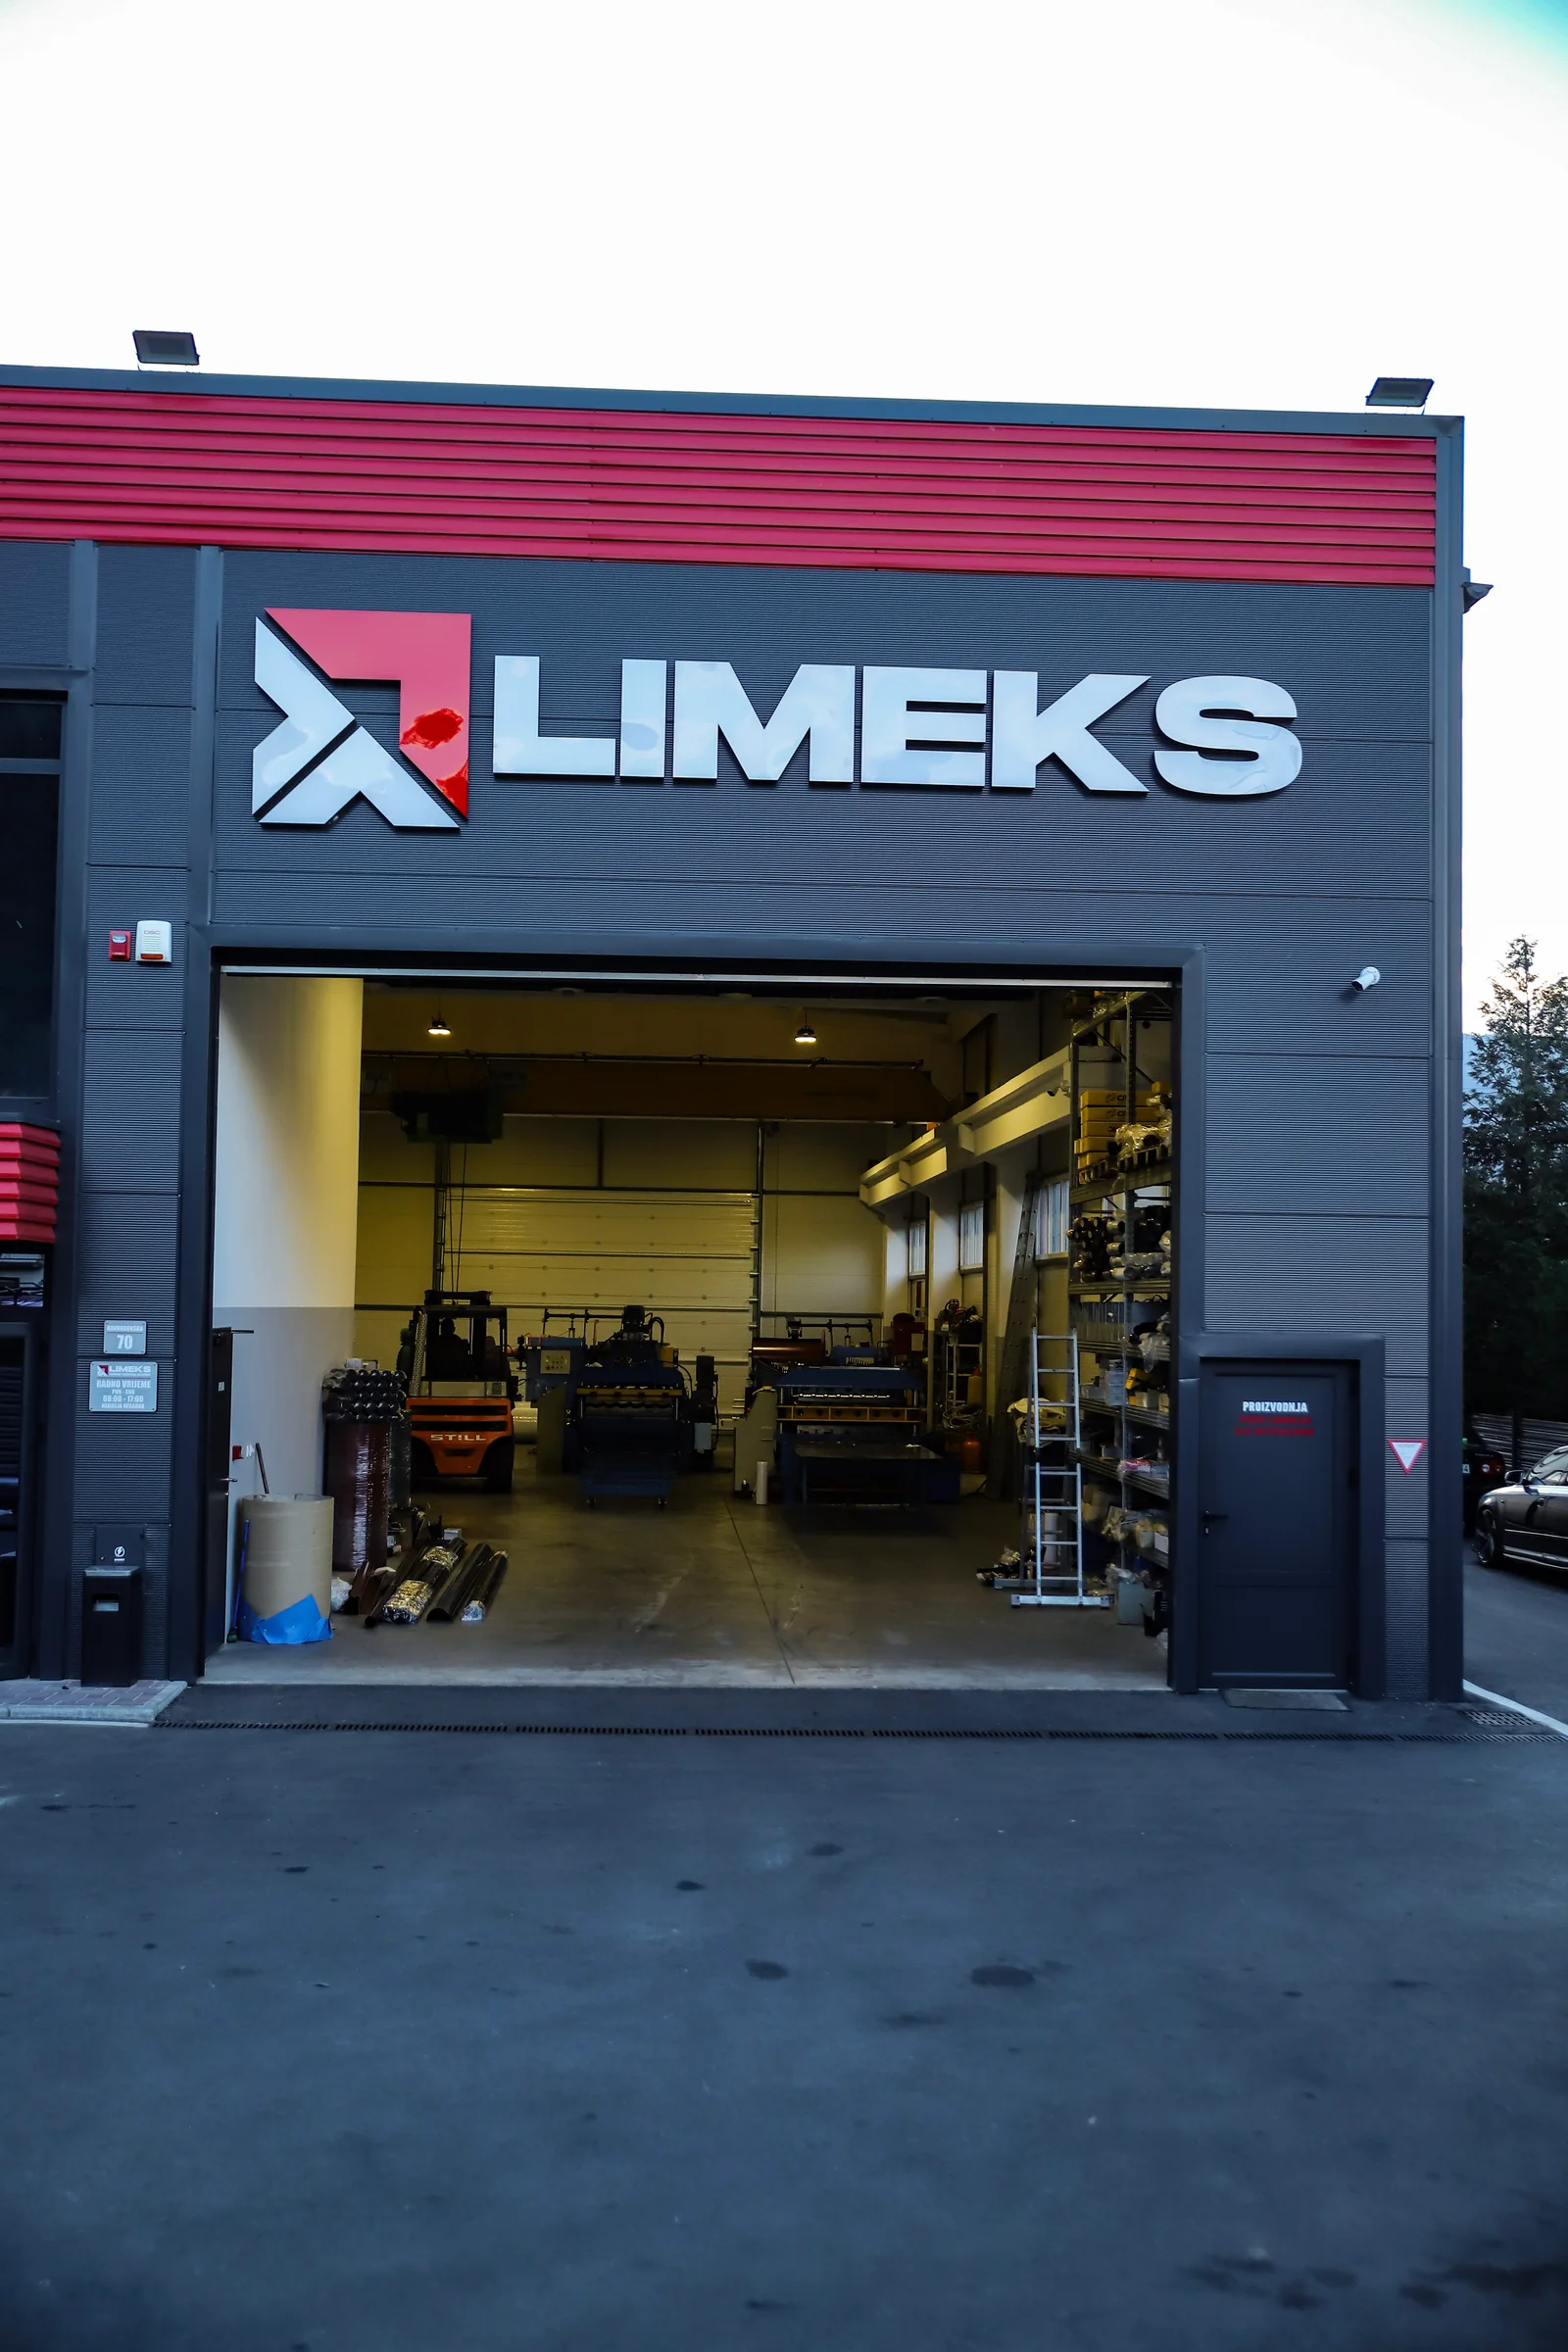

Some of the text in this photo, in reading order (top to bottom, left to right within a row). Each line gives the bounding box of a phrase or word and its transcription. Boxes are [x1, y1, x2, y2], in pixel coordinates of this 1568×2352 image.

[492, 654, 1304, 797] LIMEKS
[117, 1335, 133, 1349] 70
[122, 1380, 151, 1388] VRIJEME
[1243, 1401, 1308, 1412] PROIZVODNJA
